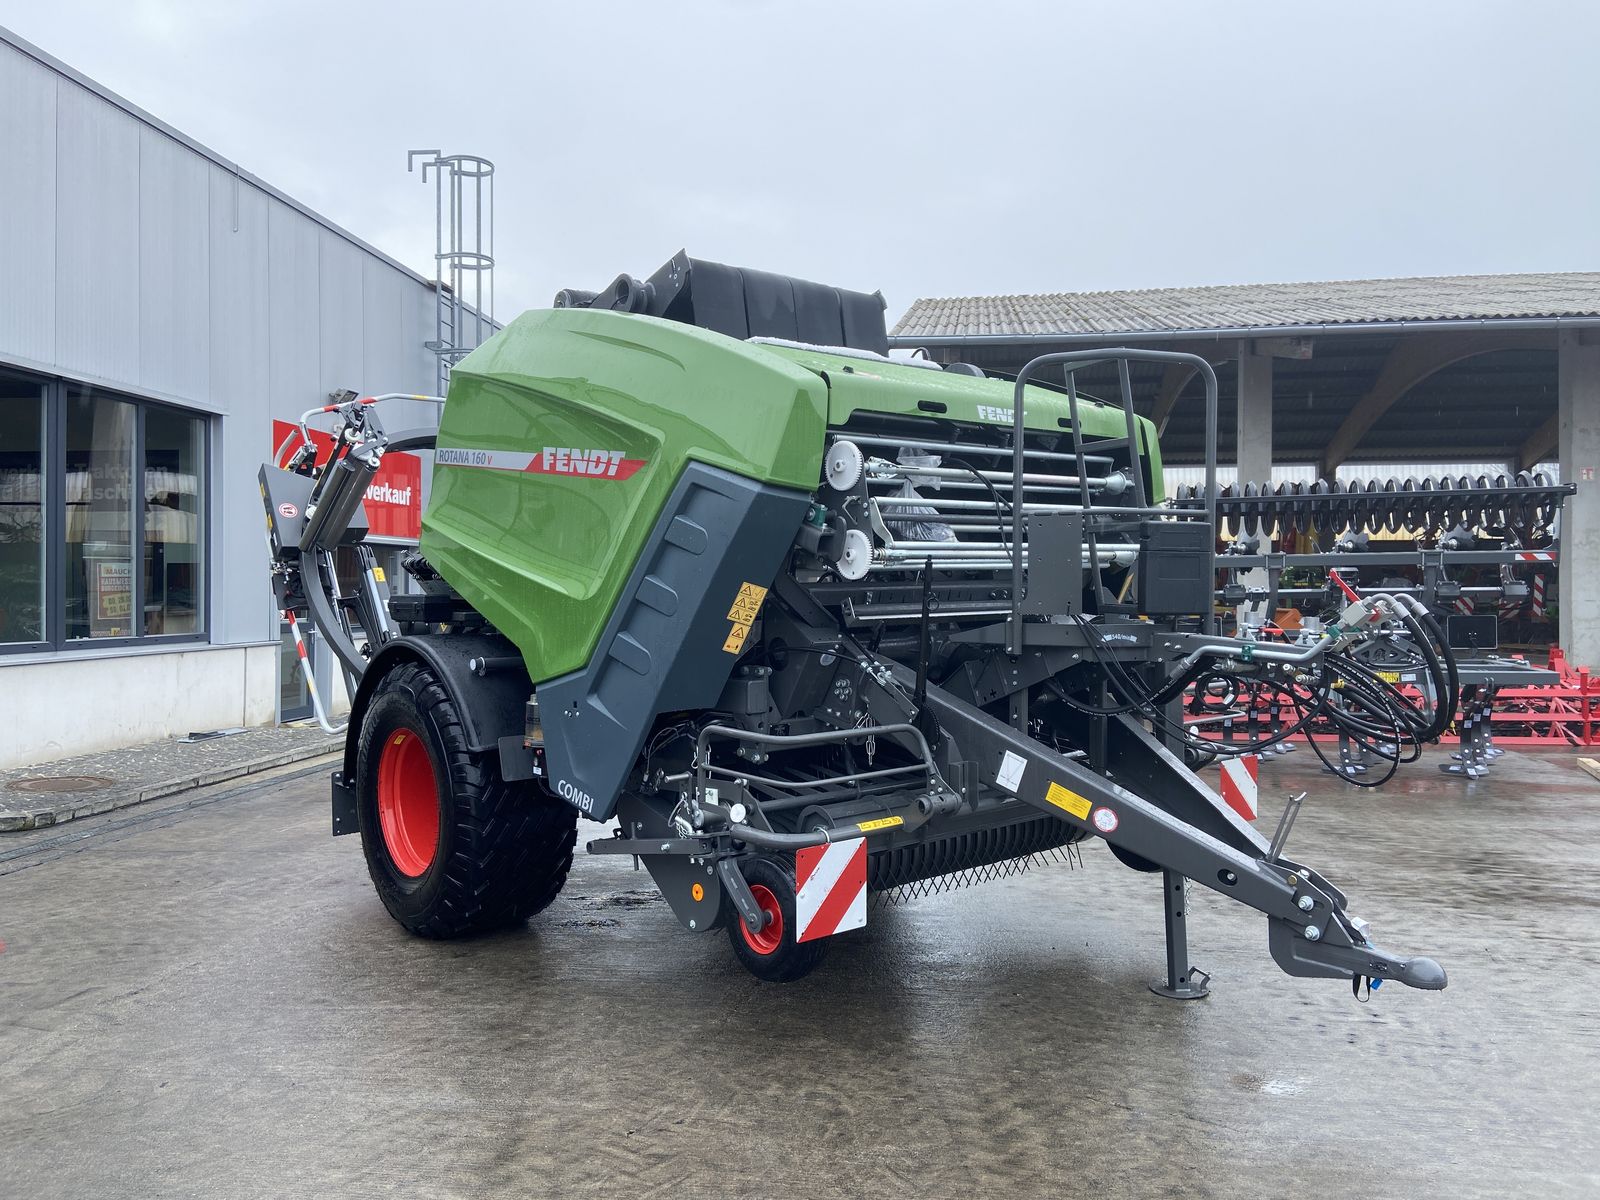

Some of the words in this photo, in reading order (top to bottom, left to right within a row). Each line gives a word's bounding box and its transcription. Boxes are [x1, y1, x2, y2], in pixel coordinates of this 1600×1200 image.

[976, 404, 1028, 423] FEND
[439, 449, 470, 463] ROTANA
[472, 451, 486, 464] 160
[542, 446, 626, 476] FENDT
[362, 482, 411, 506] verkauf
[105, 568, 131, 576] MAUC
[557, 779, 594, 813] COMBI
